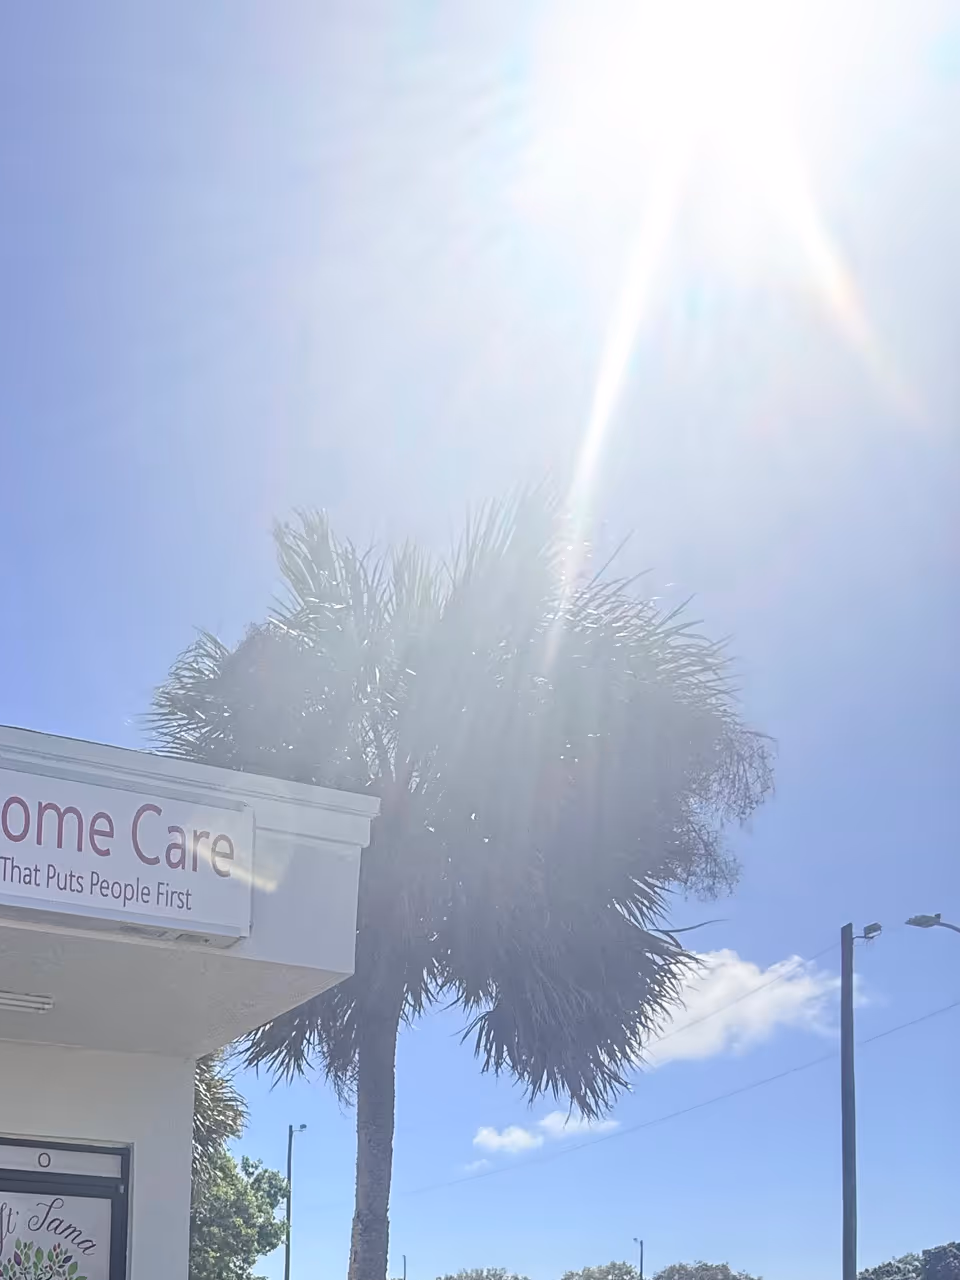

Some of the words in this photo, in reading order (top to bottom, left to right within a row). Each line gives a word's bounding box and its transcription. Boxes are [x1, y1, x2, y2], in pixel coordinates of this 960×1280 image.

[132, 803, 235, 878] Care
[0, 855, 41, 887] That
[46, 863, 84, 893] Puts
[90, 871, 151, 907] People
[156, 881, 192, 911] First
